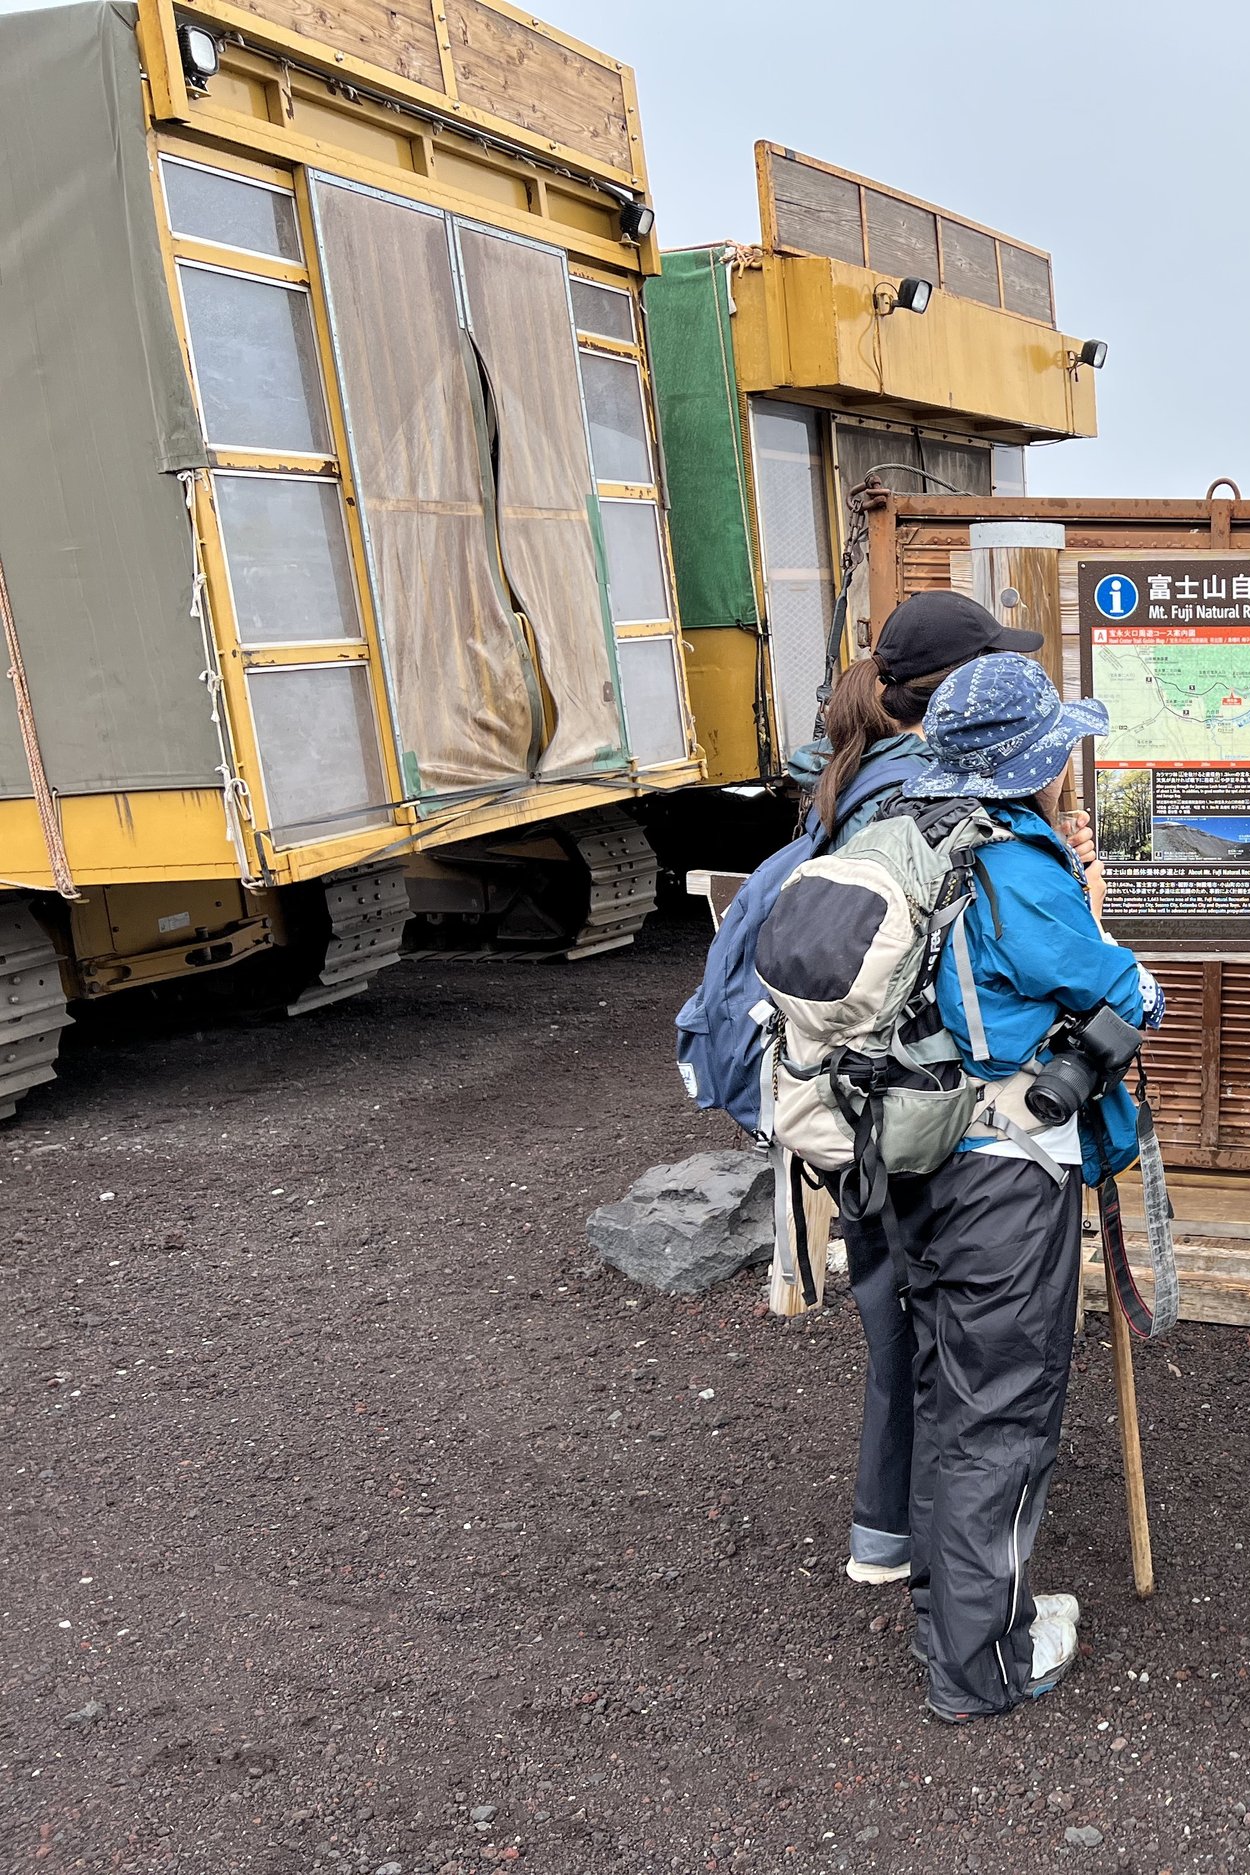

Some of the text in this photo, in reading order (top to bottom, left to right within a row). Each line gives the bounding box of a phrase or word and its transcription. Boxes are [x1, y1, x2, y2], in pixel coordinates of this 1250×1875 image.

[1149, 605, 1168, 619] Mt.
[1172, 604, 1193, 622] Fuji
[1197, 604, 1240, 619] Natural
